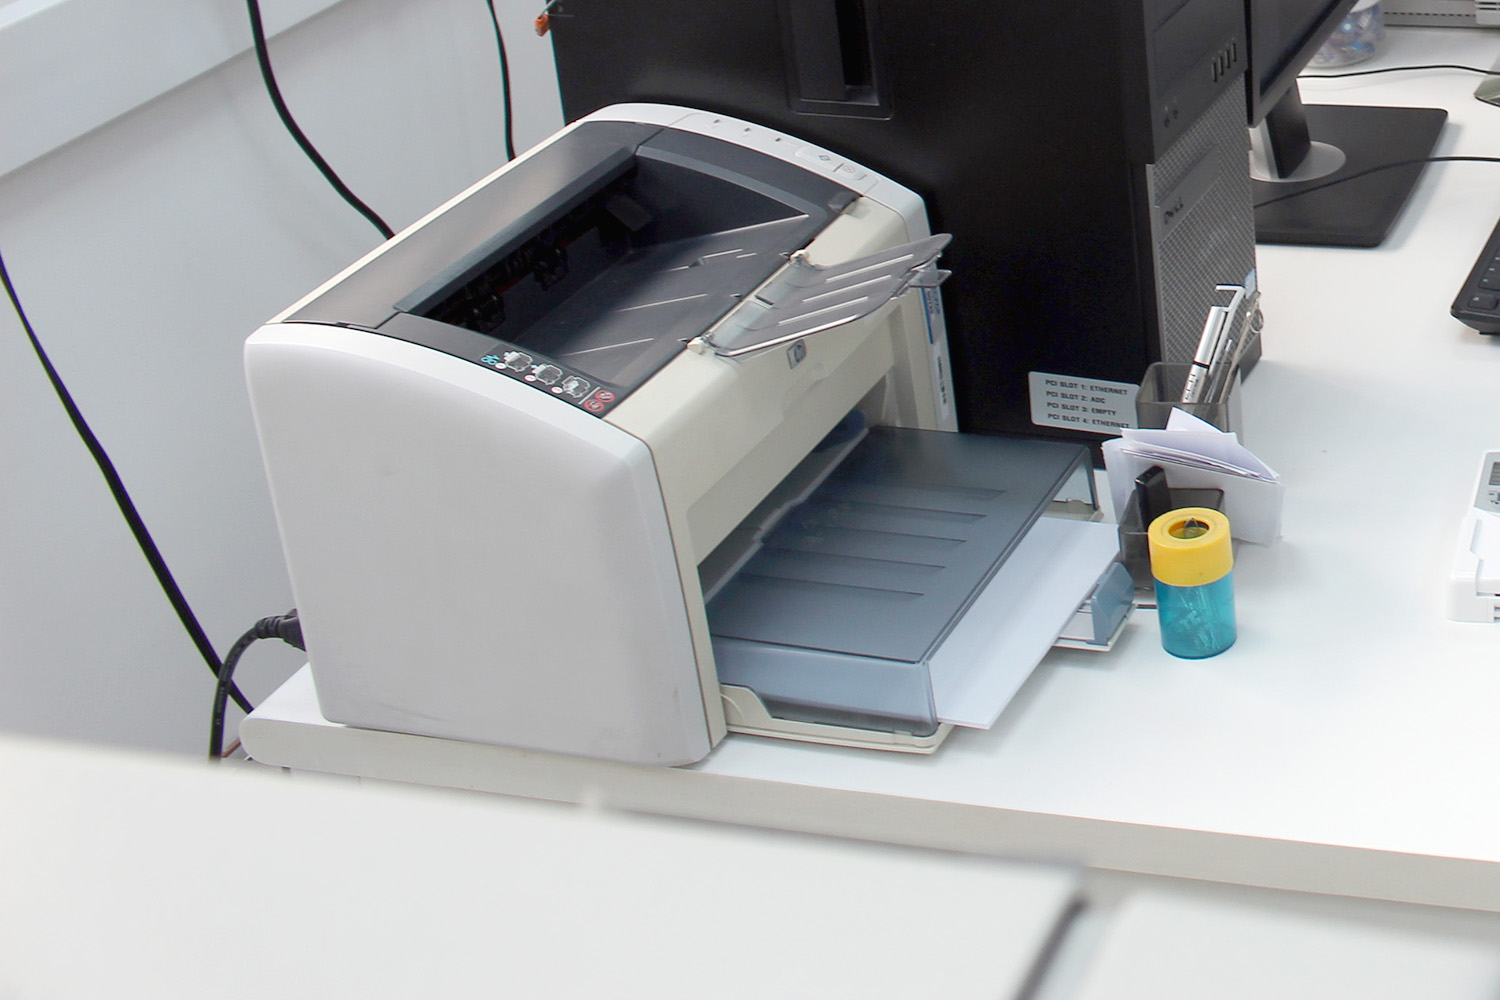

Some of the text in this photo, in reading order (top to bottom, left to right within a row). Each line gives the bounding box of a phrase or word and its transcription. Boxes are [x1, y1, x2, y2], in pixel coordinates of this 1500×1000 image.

[1060, 381, 1077, 389] SLOT
[1089, 385, 1128, 395] ETHERNET
[1061, 392, 1078, 400] SLOT
[1090, 396, 1106, 404] ADC
[1061, 403, 1079, 411] SLOT
[1091, 407, 1117, 416] EMPTY
[1092, 419, 1130, 429] ETHERNET
